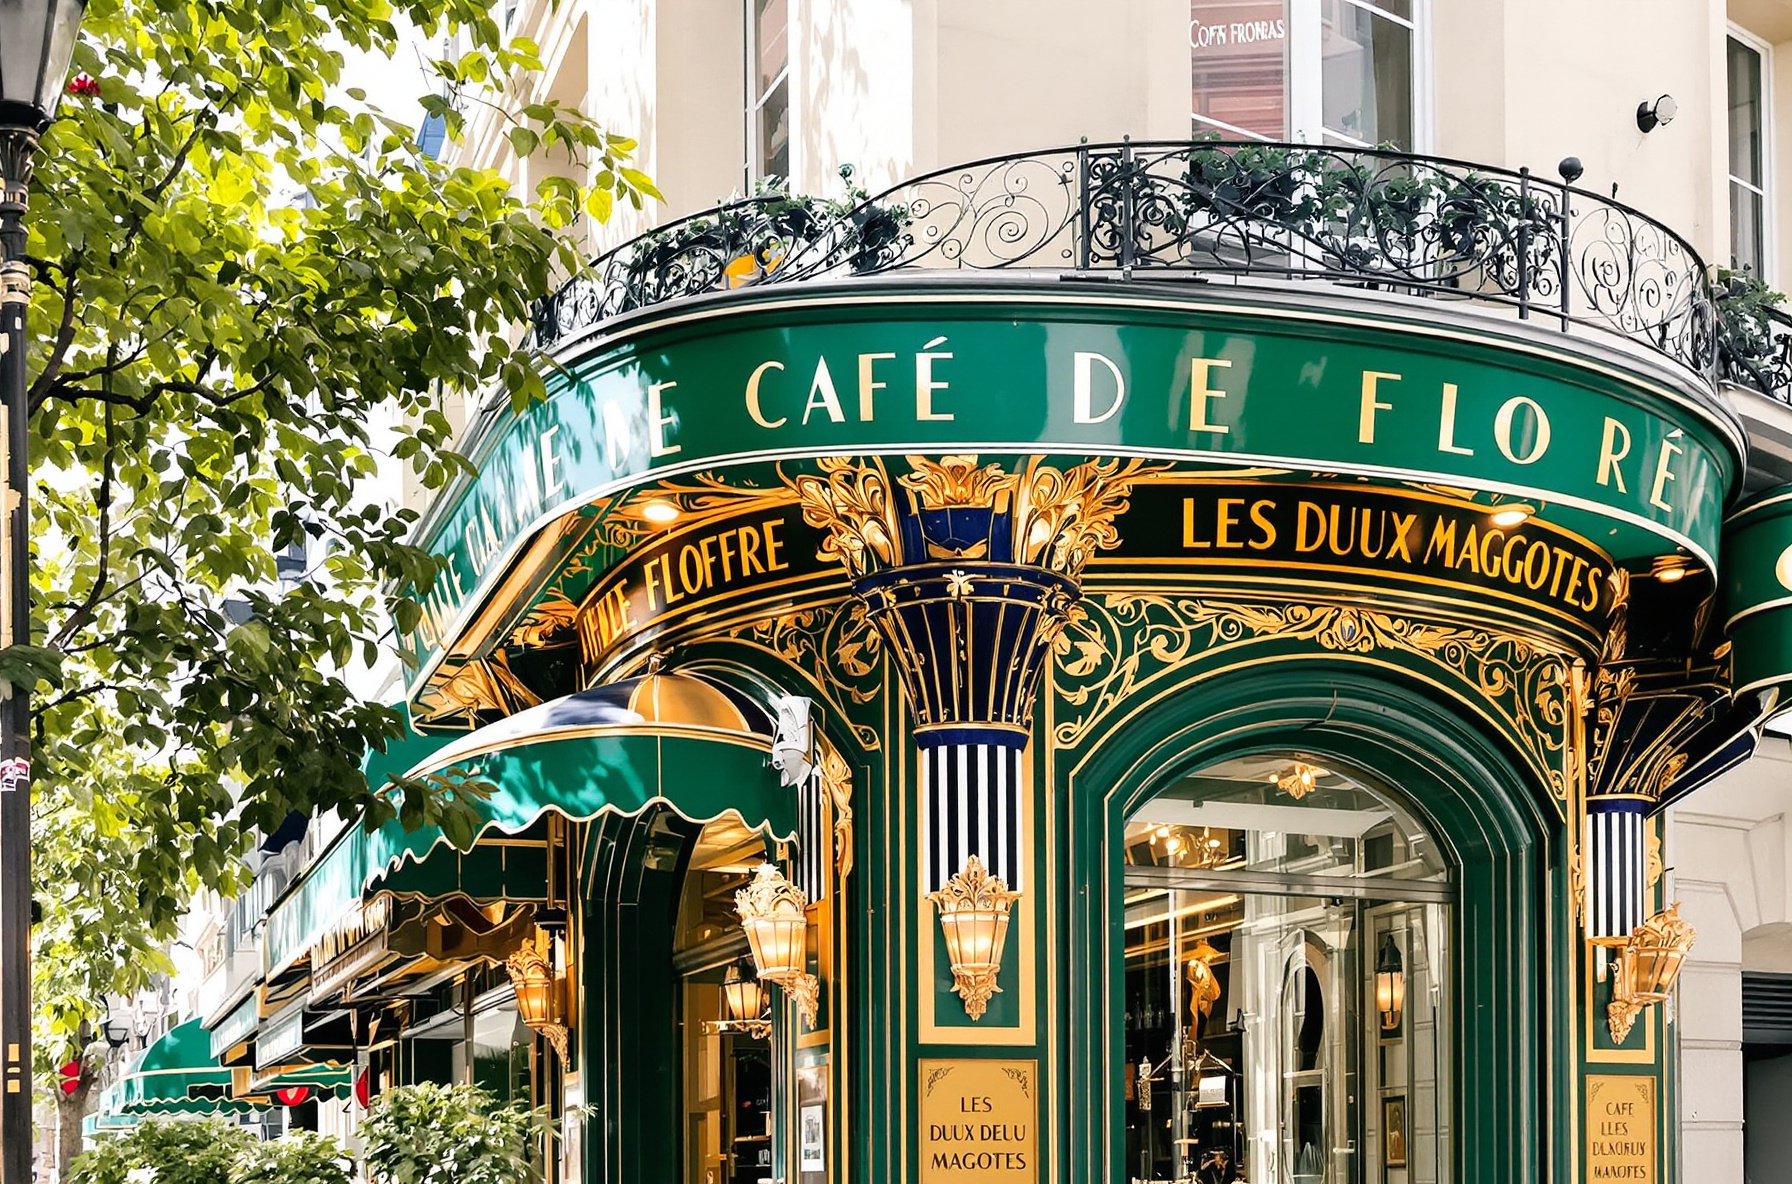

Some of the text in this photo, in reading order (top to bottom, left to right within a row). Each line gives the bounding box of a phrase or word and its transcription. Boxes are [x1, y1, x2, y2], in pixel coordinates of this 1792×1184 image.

[745, 336, 955, 429] CAFÉ
[1073, 352, 1232, 434] DE
[1357, 368, 1684, 514] FLORÉ
[643, 517, 789, 612] FLOFFRE
[1183, 498, 1603, 613] LES DUUX MAGGOTES
[930, 1124, 974, 1141] DUUX
[960, 1096, 993, 1113] LES
[931, 1152, 1027, 1170] MAGOTES
